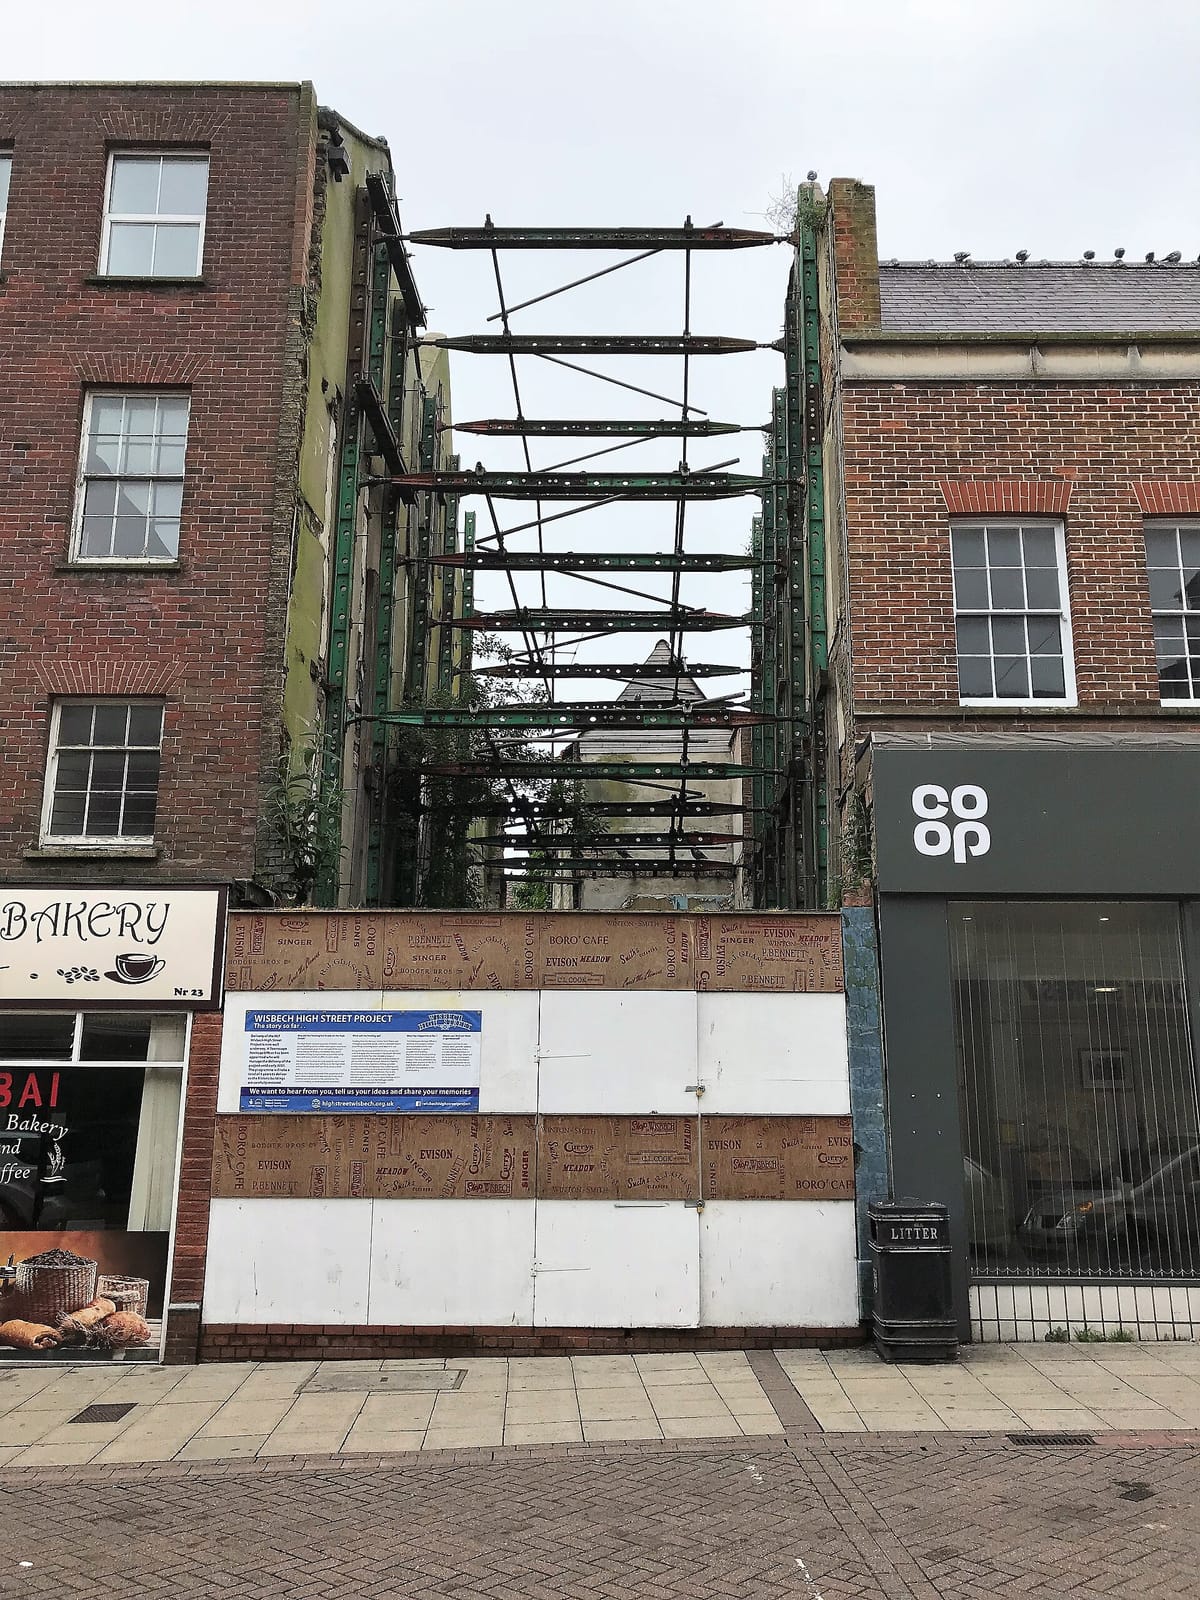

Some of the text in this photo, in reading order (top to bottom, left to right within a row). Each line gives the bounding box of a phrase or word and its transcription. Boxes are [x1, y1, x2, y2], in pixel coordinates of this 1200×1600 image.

[0, 901, 170, 944] BAKERY
[764, 928, 796, 938] EVISON
[235, 926, 245, 958] EVISON
[583, 935, 609, 945] CAFE
[546, 955, 612, 967] EVISON MEADOW
[716, 945, 726, 977] EVISON
[174, 988, 204, 997] Nr 23
[254, 1014, 393, 1023] WISBECH HIGH STREET PROJECT
[6, 1113, 69, 1141] Bakery
[0, 1138, 21, 1154] nd
[564, 1142, 594, 1154] Currys
[708, 1140, 741, 1150] EVISON
[420, 1149, 453, 1159] EVISON
[818, 1153, 848, 1165] Currys
[258, 1160, 292, 1170] EVISON
[376, 1167, 409, 1175] MEADOW
[405, 1154, 433, 1183] SINGER
[890, 1227, 938, 1240] LITTER
